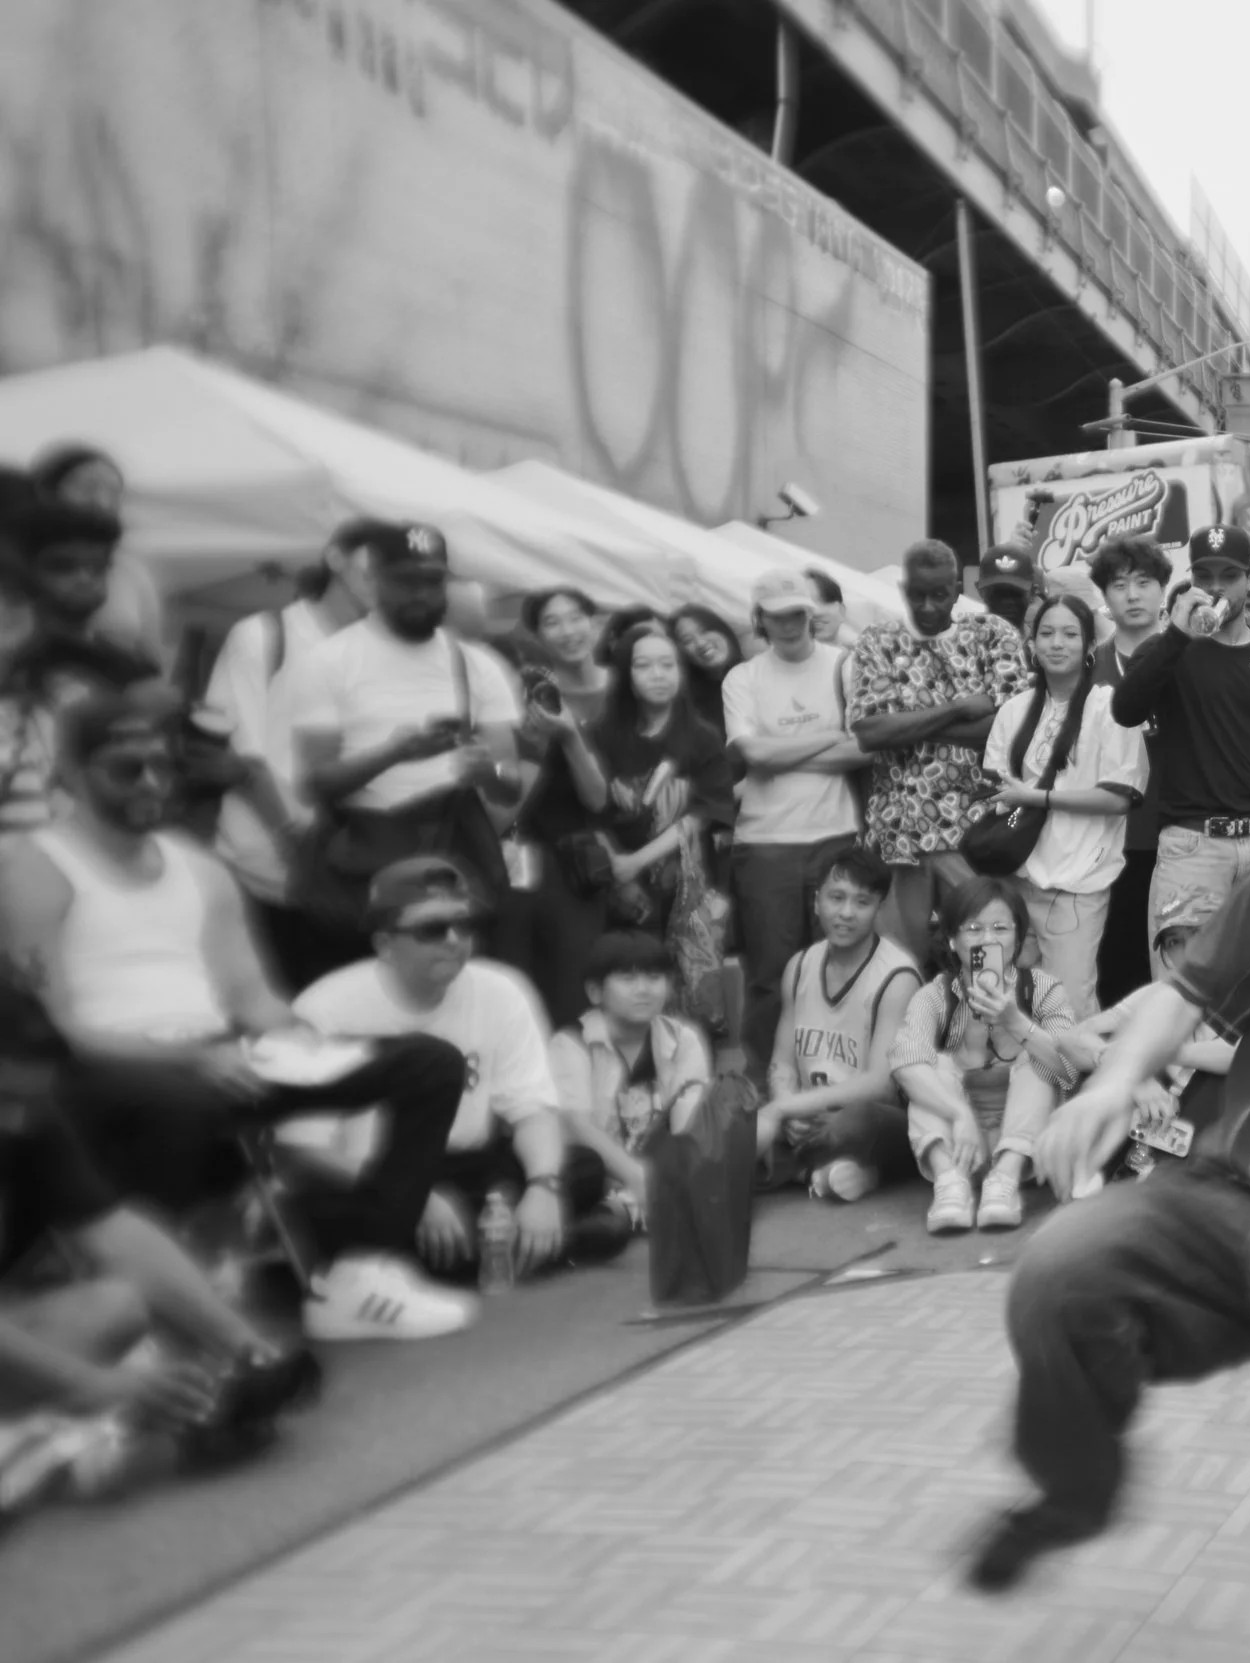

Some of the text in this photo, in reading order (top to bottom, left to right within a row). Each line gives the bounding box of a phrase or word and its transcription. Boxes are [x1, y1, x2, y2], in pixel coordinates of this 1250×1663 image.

[1043, 473, 1160, 567] Pressure
[1107, 509, 1153, 537] PAINT
[795, 1028, 858, 1069] HOYAS
